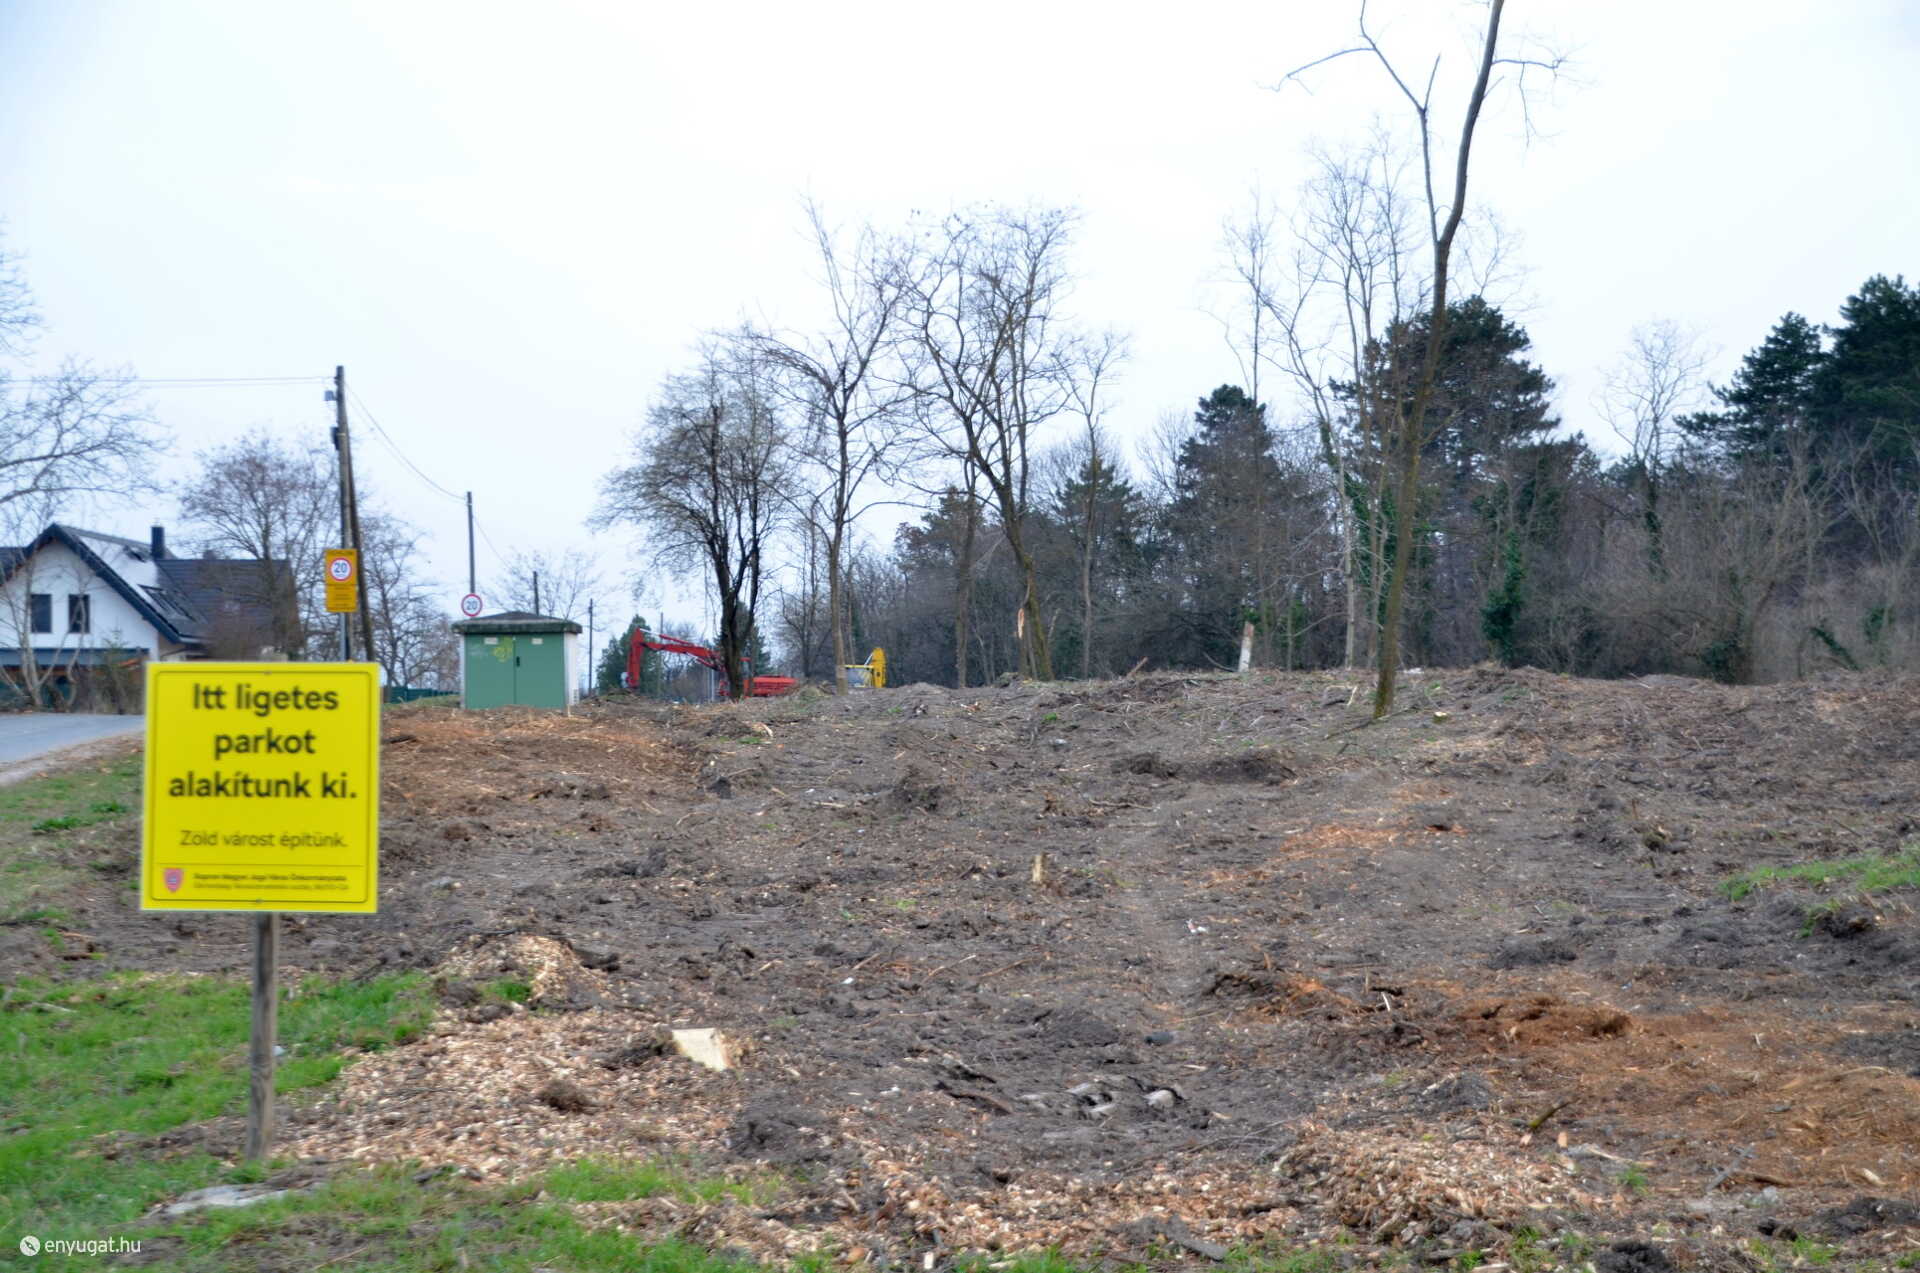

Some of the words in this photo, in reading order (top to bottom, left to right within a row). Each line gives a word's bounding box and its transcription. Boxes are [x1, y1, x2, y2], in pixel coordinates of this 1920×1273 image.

[333, 562, 348, 573] 20
[466, 600, 478, 610] 20
[193, 683, 226, 710] Itt
[236, 683, 339, 717] ligetes
[214, 728, 316, 760] parkot
[168, 771, 310, 798] alakítunk
[321, 772, 357, 799] ki.
[223, 830, 274, 847] várost
